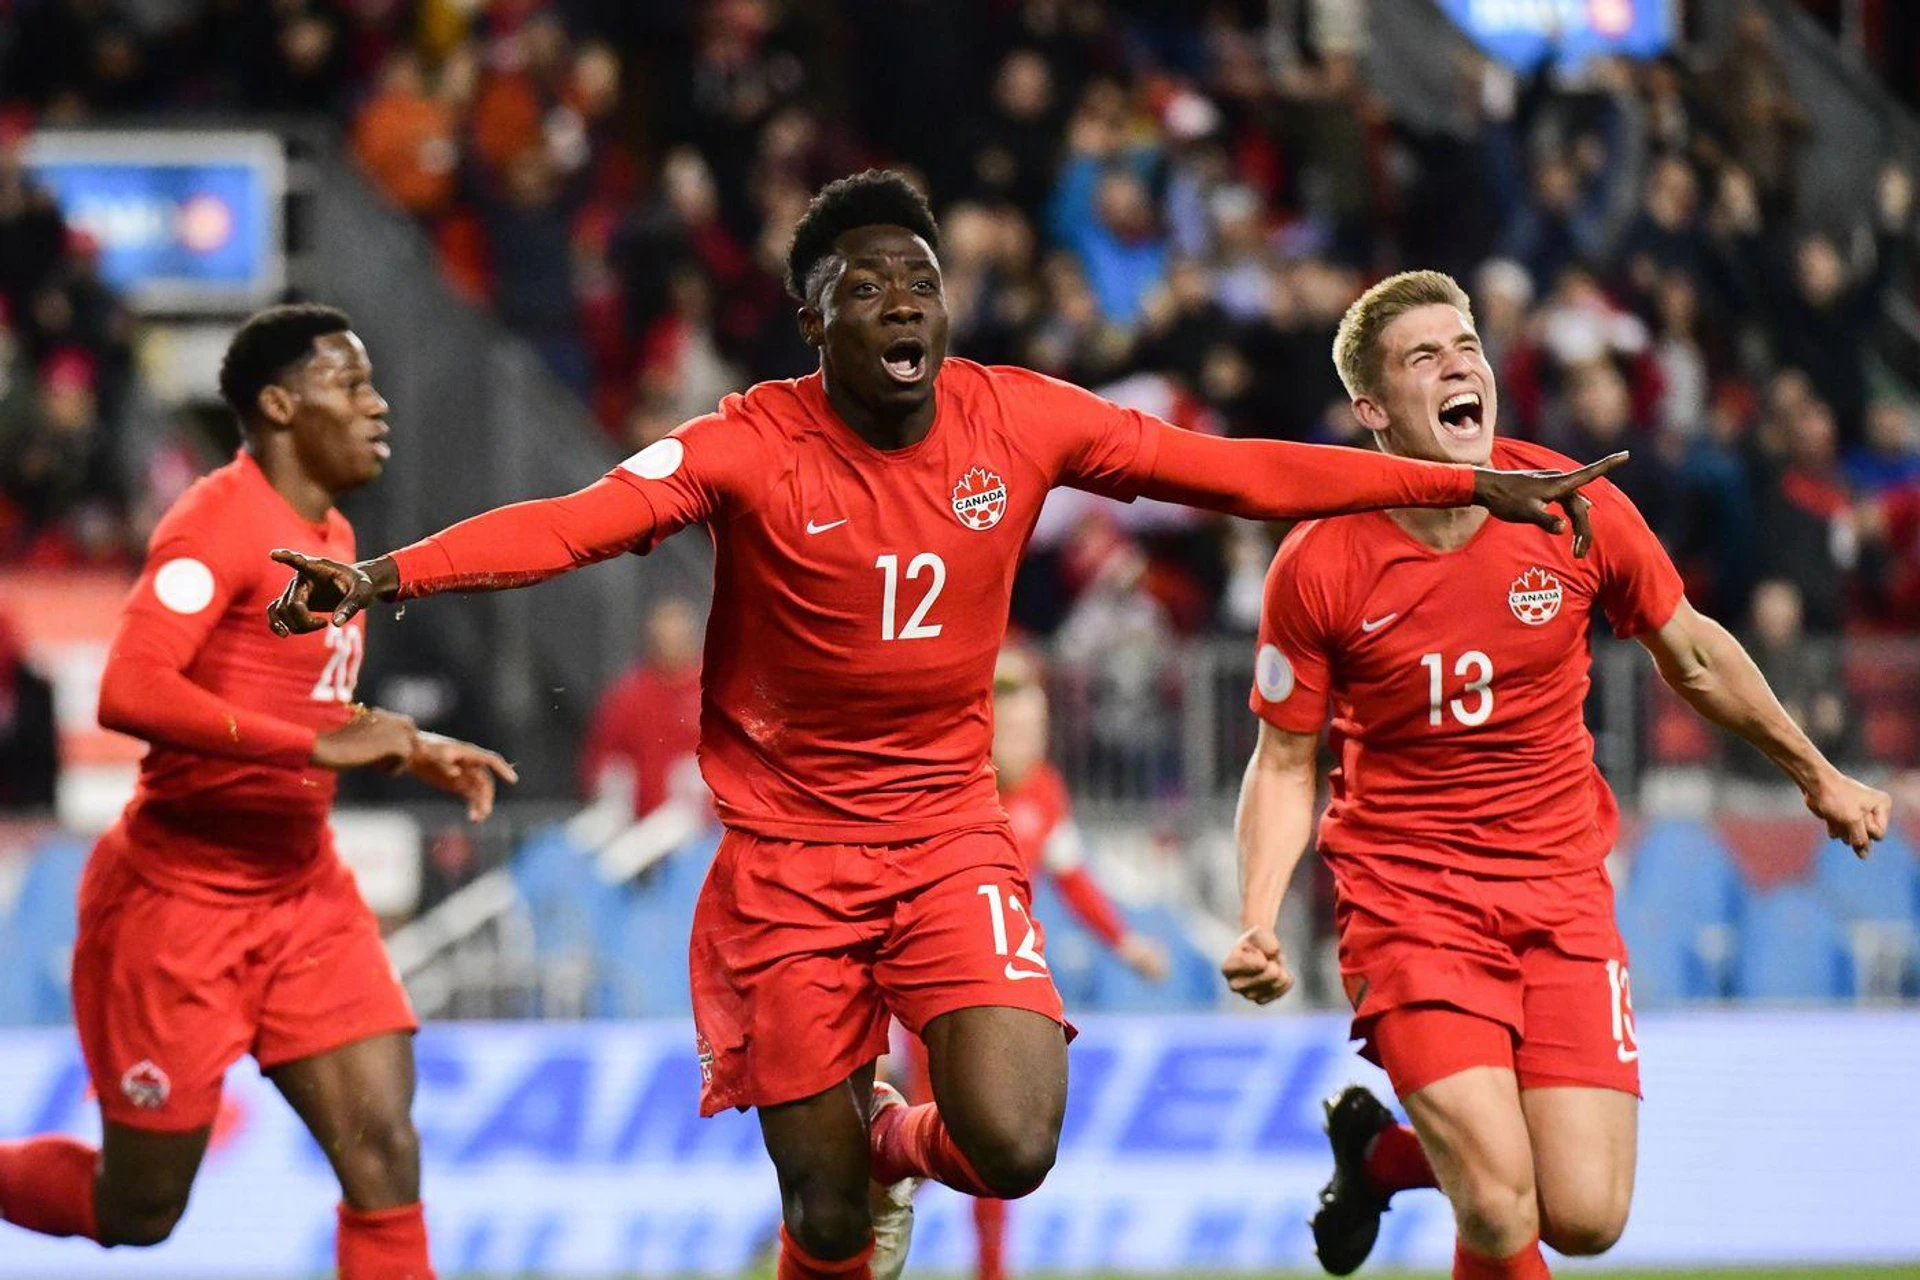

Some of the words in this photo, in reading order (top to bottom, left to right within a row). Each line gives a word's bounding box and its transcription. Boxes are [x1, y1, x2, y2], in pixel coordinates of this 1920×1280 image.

[955, 490, 1005, 510] CANADA
[875, 552, 947, 641] 12
[1511, 592, 1560, 603] CANADA
[310, 622, 364, 703] 20
[1420, 649, 1494, 727] 13
